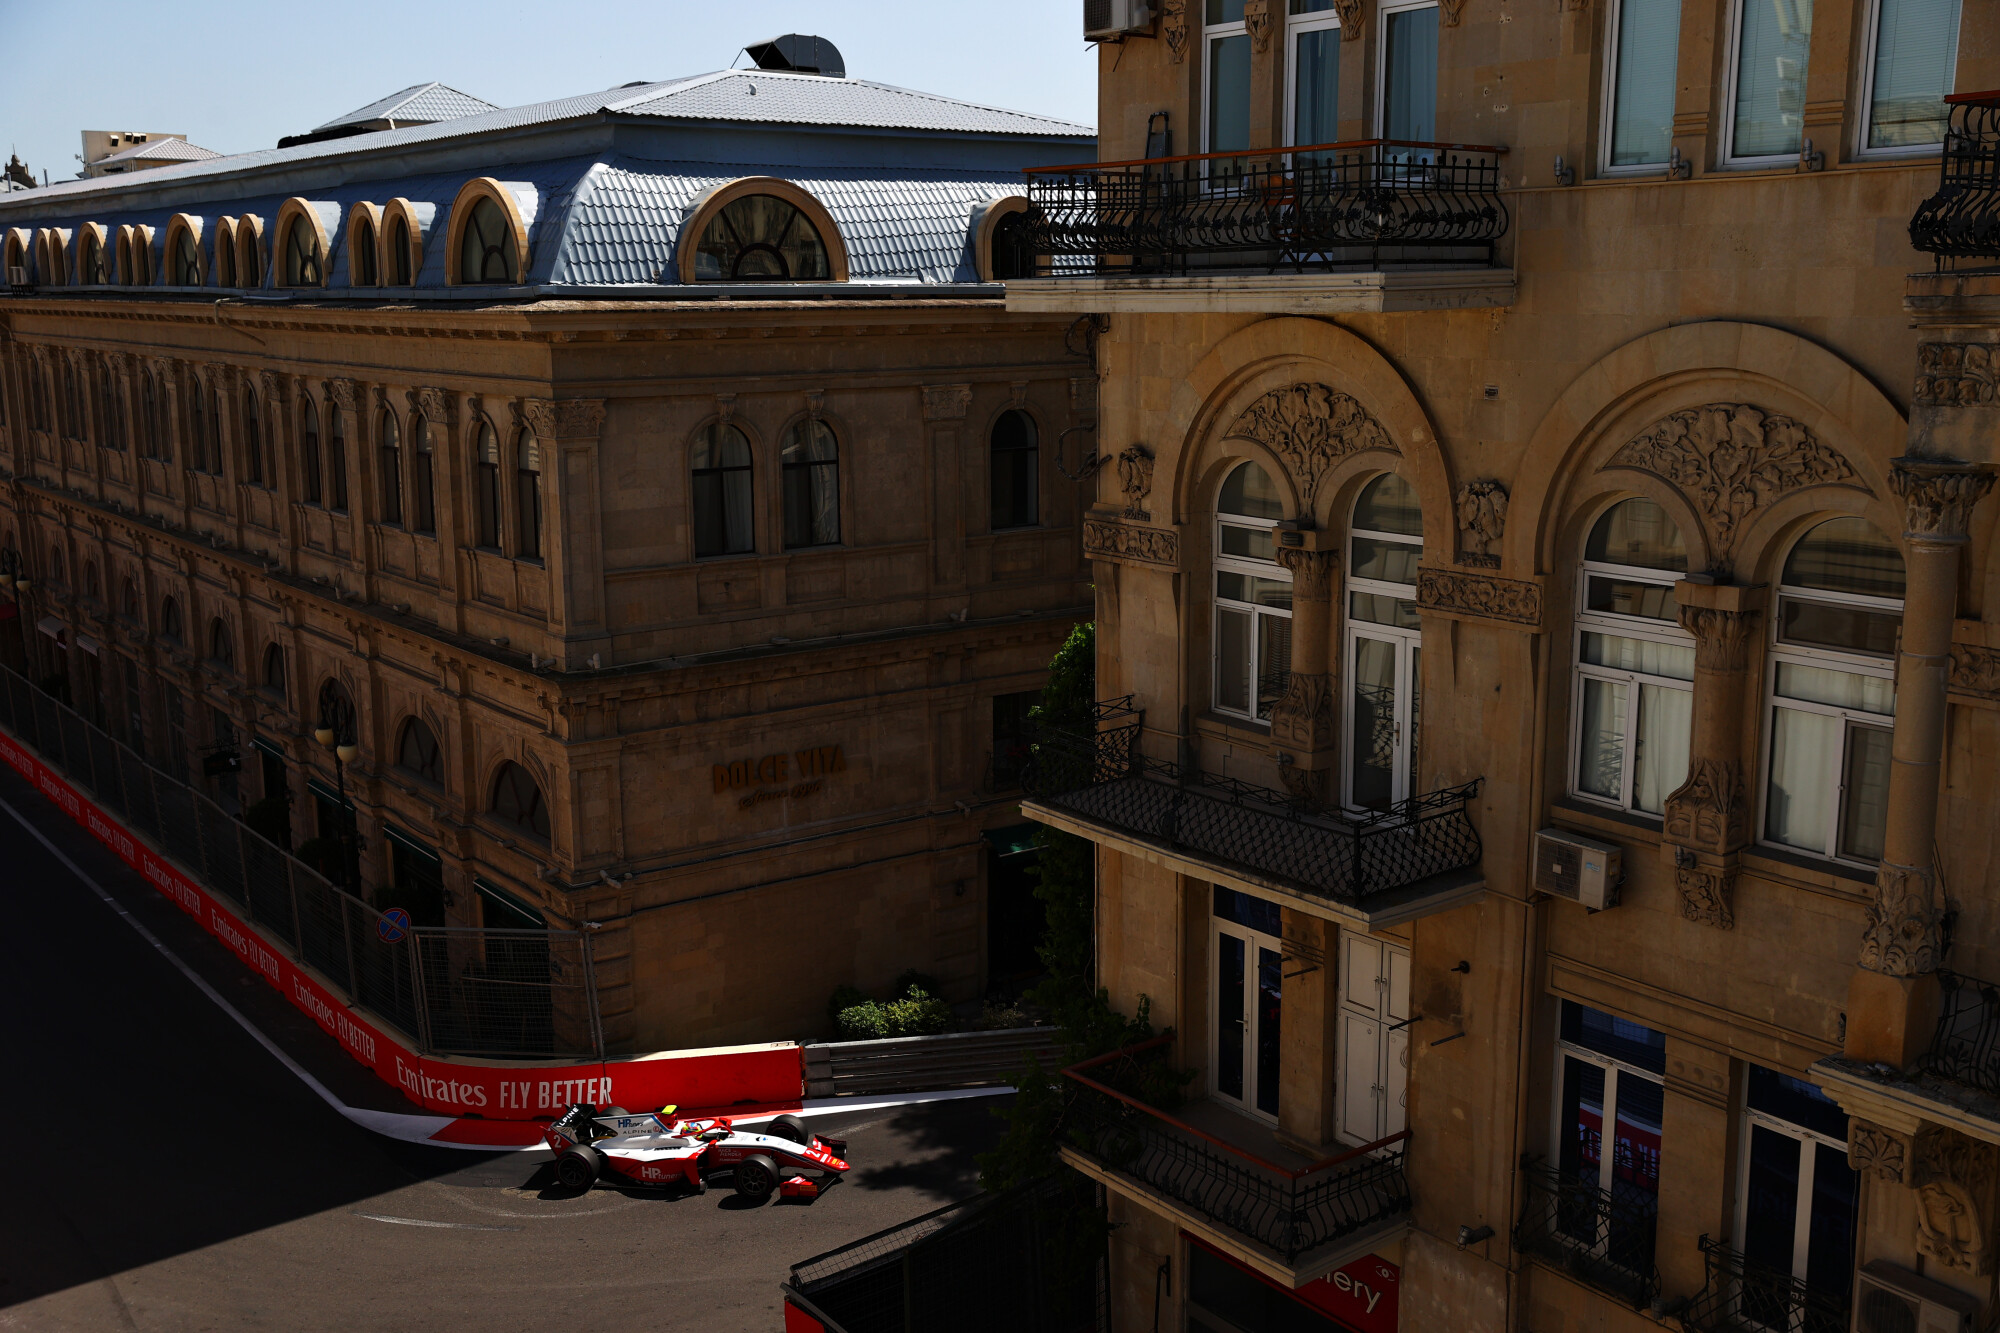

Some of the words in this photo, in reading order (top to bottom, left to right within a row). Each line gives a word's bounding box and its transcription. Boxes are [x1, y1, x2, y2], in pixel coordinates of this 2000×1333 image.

[713, 754, 788, 794] DOLCE
[796, 744, 847, 777] VITA
[86, 808, 113, 845] Emirates
[143, 853, 173, 894] Emirates
[174, 878, 184, 902] FLY
[183, 885, 201, 916] BETTER
[211, 907, 247, 955] Emirates
[249, 938, 258, 965] FLY
[257, 947, 280, 983] BETTER
[292, 974, 336, 1030] Emirates
[337, 1012, 349, 1041] FLY
[349, 1022, 376, 1063] BETTER
[395, 1055, 487, 1107] Emirates
[500, 1081, 531, 1109] FLY
[538, 1077, 613, 1109] BETTER
[553, 1135, 562, 1148] 2
[806, 1150, 821, 1158] 2
